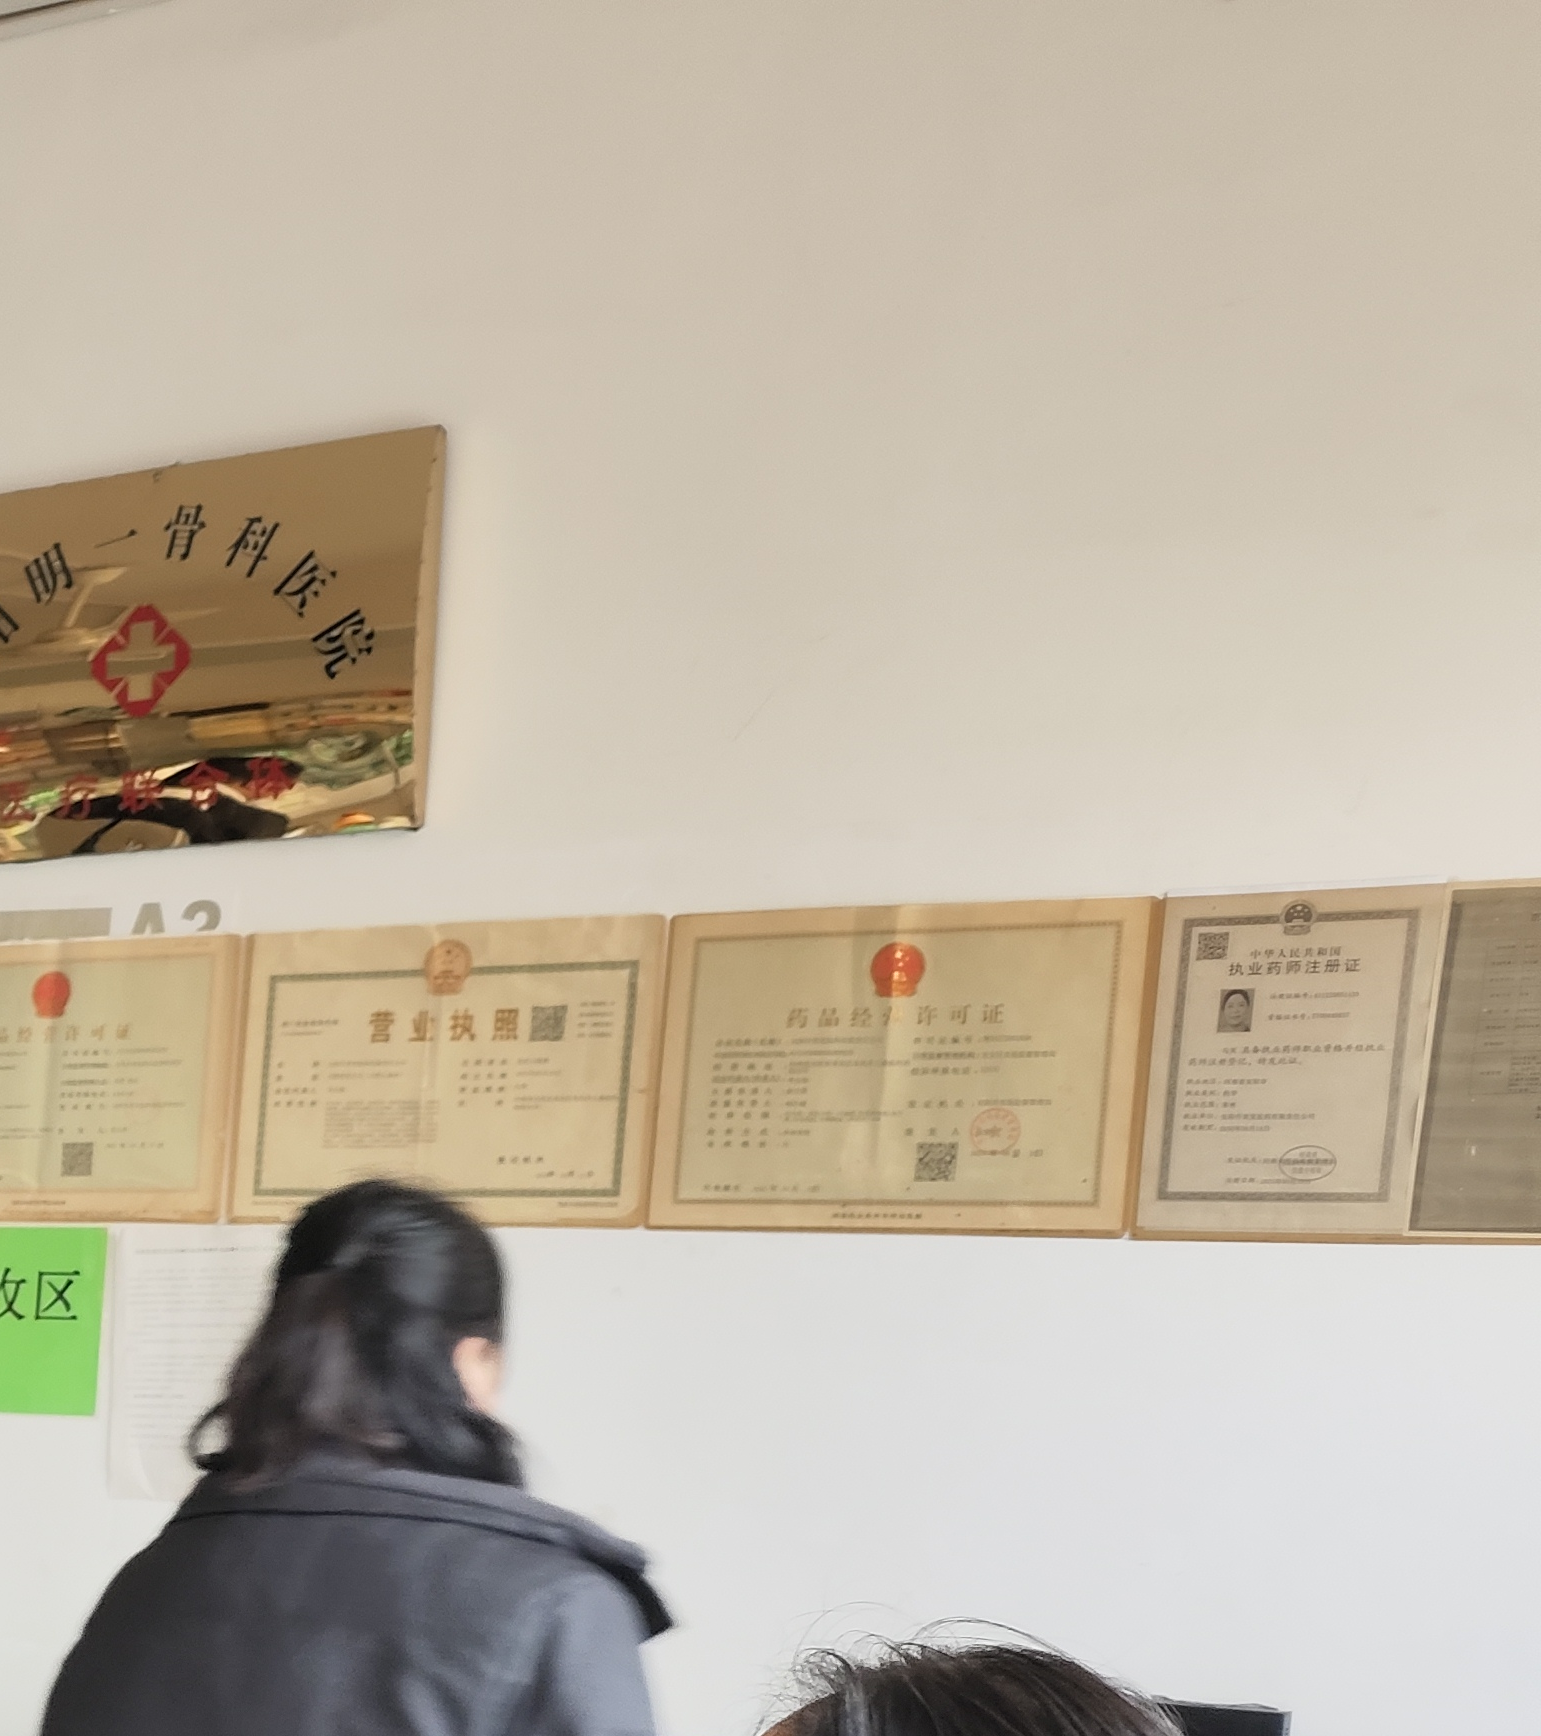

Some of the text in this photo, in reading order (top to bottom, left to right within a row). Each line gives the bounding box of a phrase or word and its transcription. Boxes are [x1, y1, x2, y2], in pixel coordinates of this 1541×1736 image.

[1249, 945, 1343, 959] 中华人民共和国
[1228, 957, 1362, 977] 执业药师注册证
[368, 1008, 520, 1043] 营业执照
